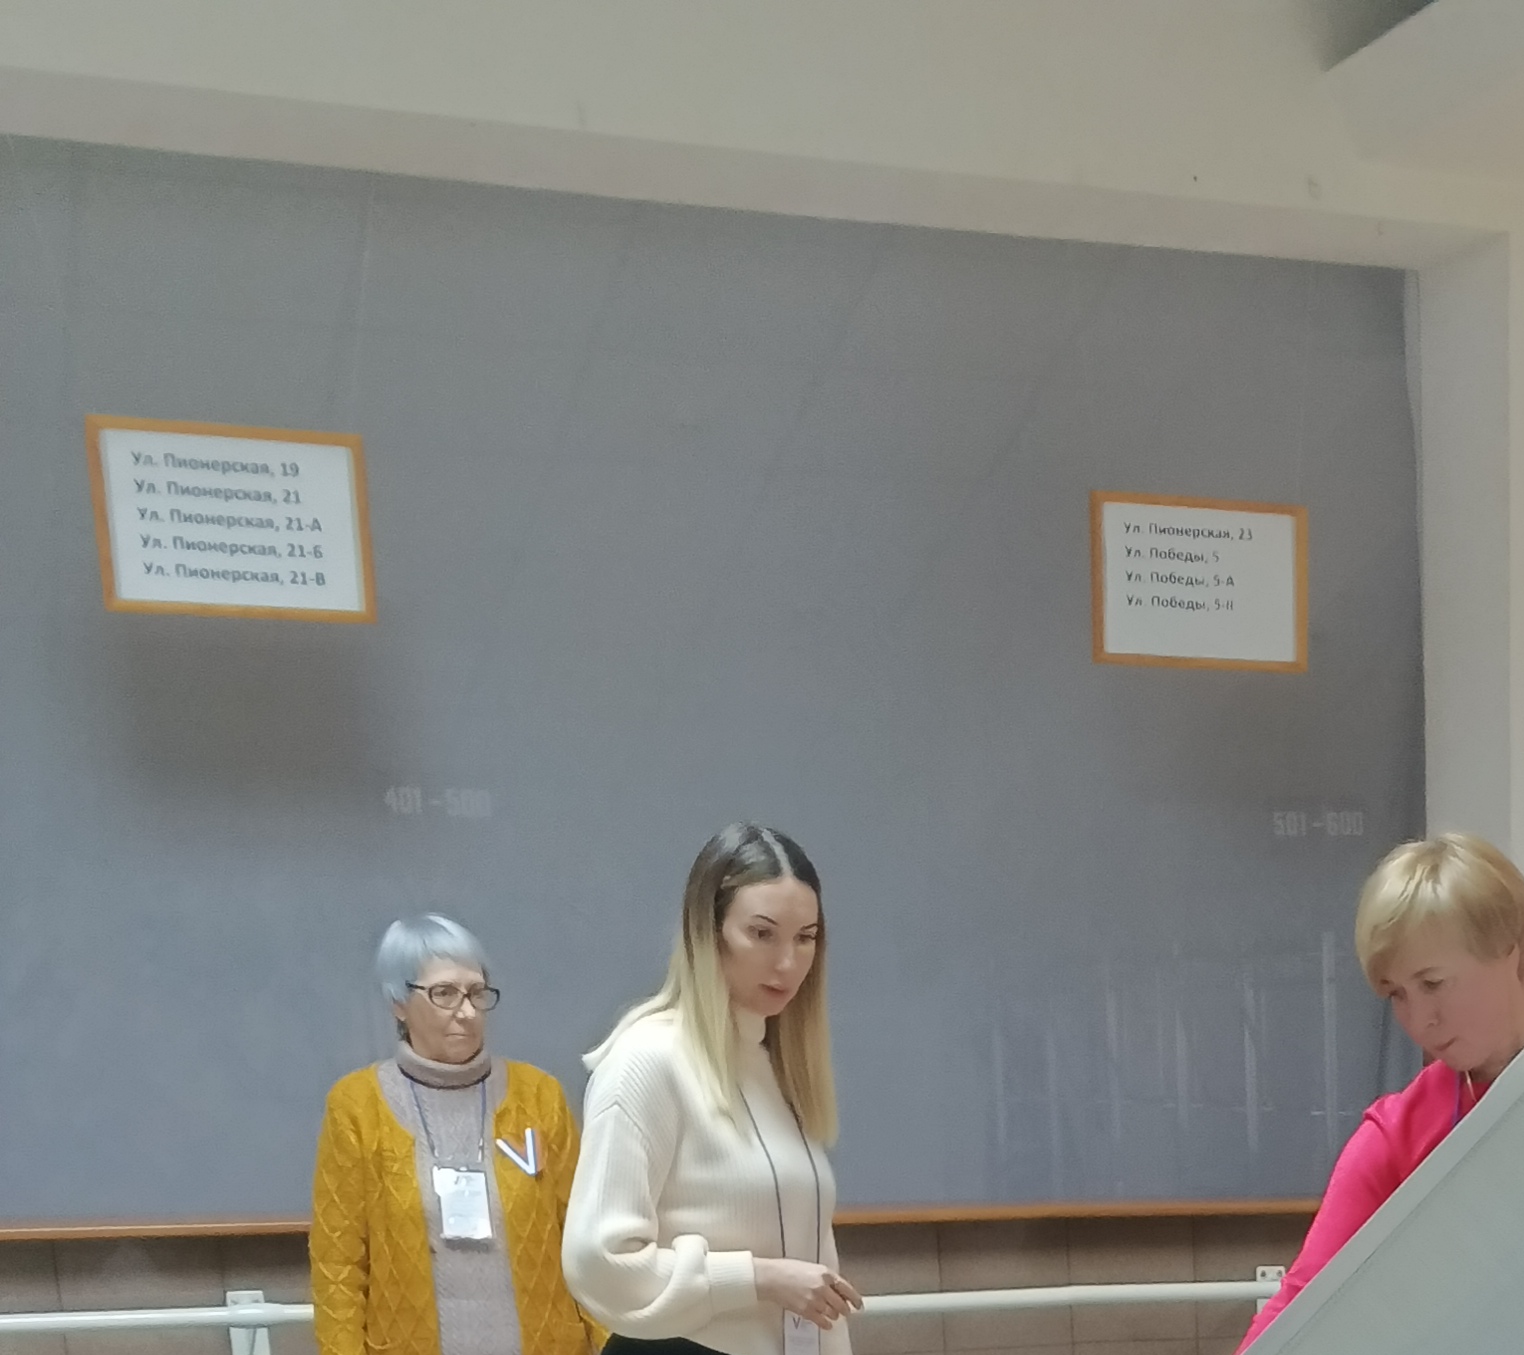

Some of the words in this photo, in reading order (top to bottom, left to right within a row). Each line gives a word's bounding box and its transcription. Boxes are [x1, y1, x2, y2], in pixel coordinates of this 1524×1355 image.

[131, 451, 157, 465] Ул.
[163, 453, 275, 476] Пионерская,
[280, 462, 300, 477] 19
[133, 478, 160, 493] Ул.
[166, 481, 278, 504] Пионерская,
[282, 489, 301, 504] 21
[136, 506, 164, 522] Ул.
[169, 508, 280, 532] Пионерская,
[284, 516, 323, 533] 21-А
[1149, 523, 1234, 540] Пионерская,
[140, 533, 167, 549] Ул.
[172, 536, 282, 558] Пионерская,
[1150, 547, 1208, 564] Победы,
[143, 561, 169, 577] Ул.
[175, 563, 284, 585] Пионерская,
[1150, 571, 1209, 587] Победы,
[1151, 596, 1209, 611] Победы,
